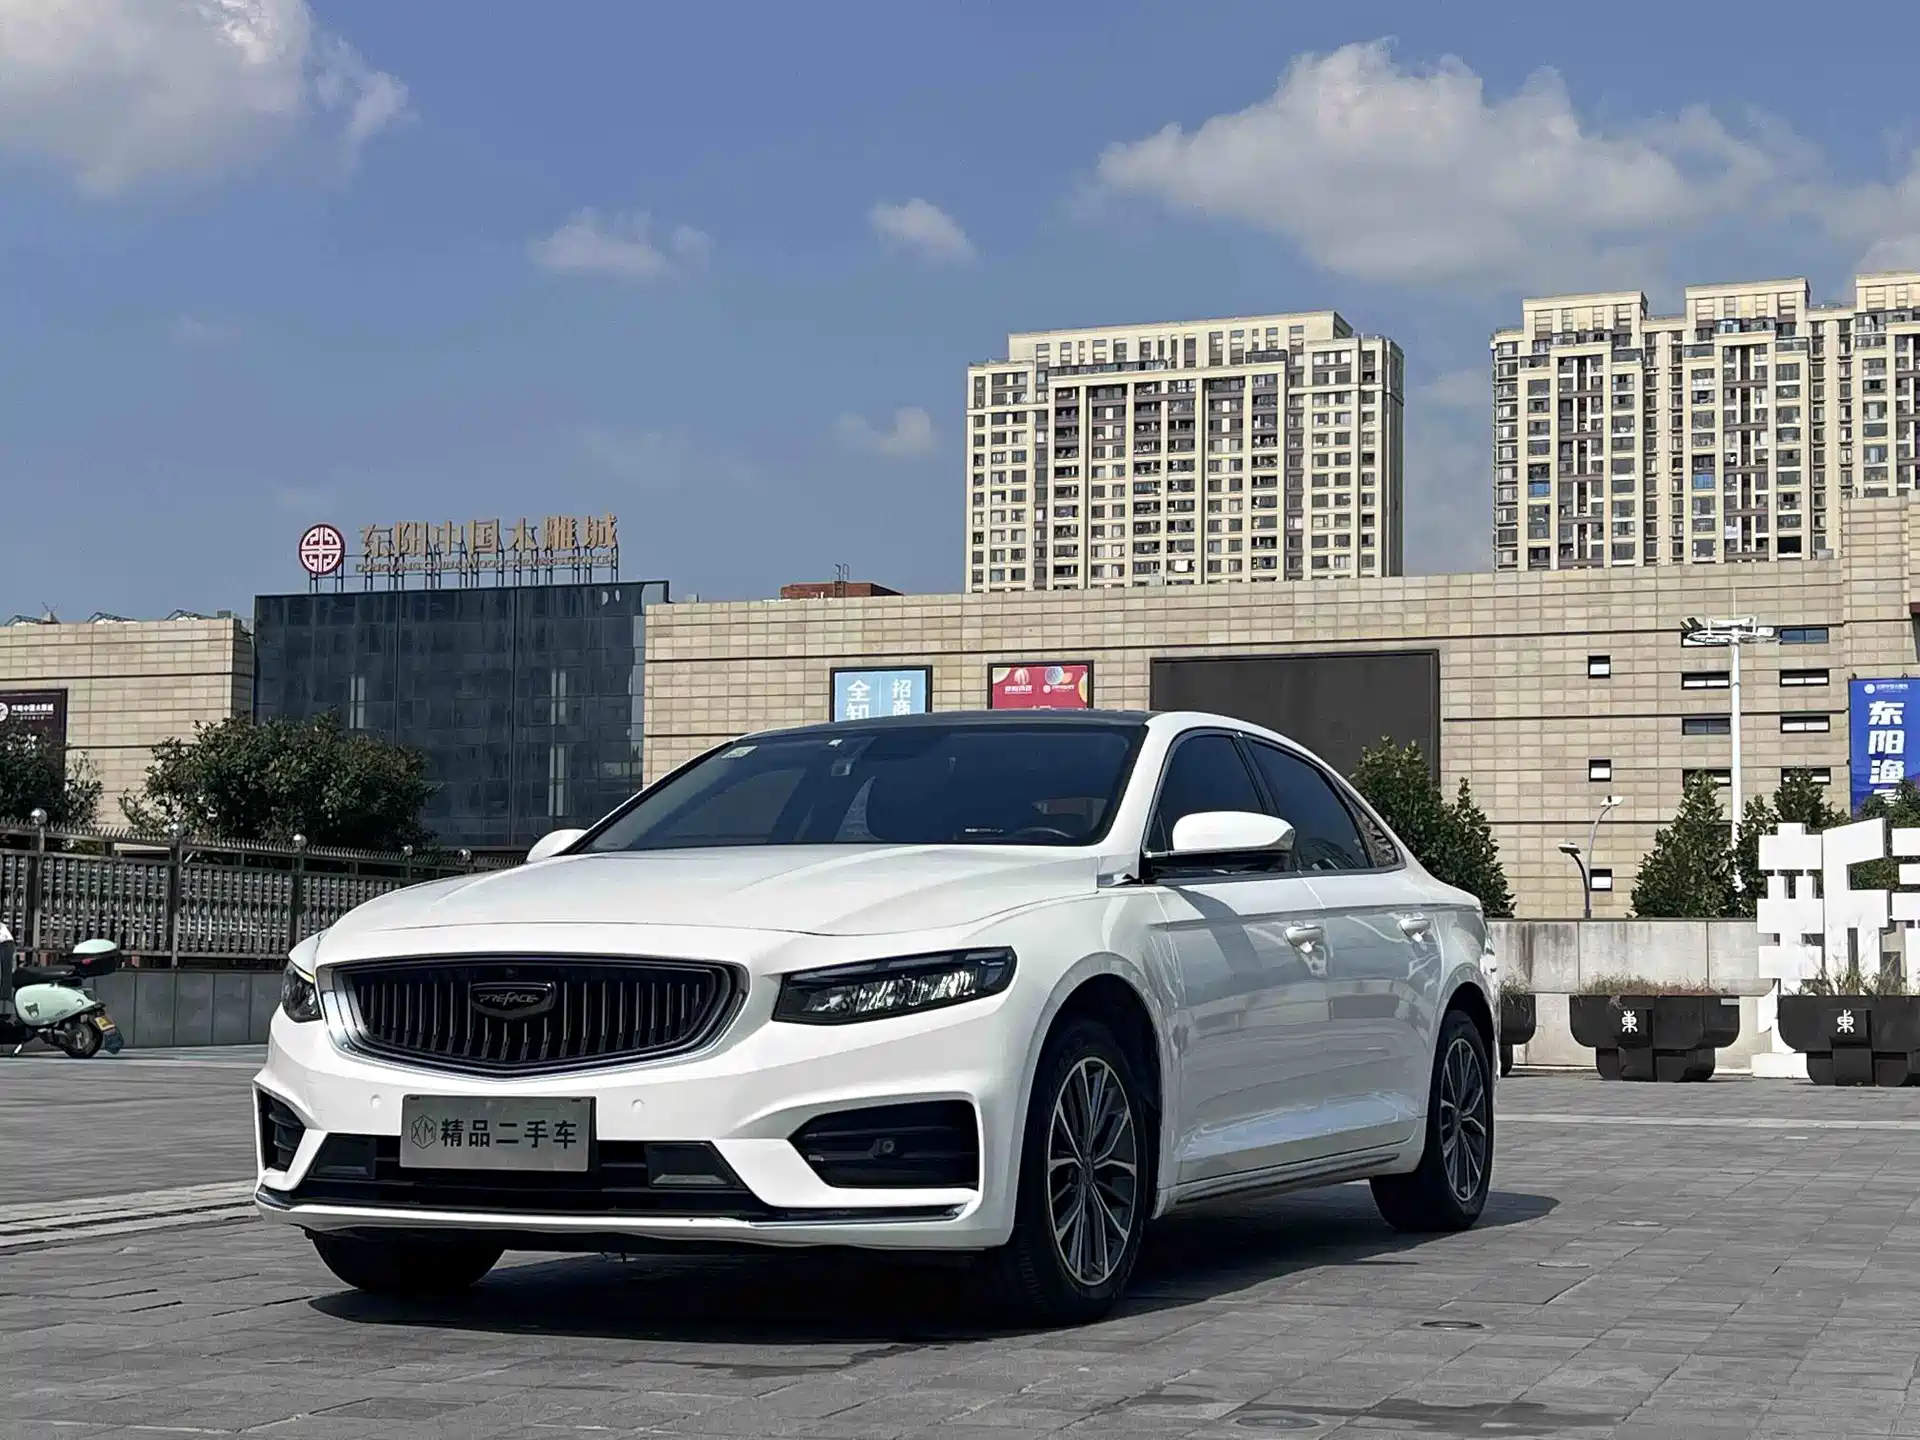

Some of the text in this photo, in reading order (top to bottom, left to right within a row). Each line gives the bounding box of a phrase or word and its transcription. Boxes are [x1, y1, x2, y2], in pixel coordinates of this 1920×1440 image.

[360, 512, 617, 558] 东阳中国木雕城
[892, 678, 912, 716] 招商
[478, 991, 540, 1006] PREFACE
[440, 1118, 577, 1149] 精品二手车
